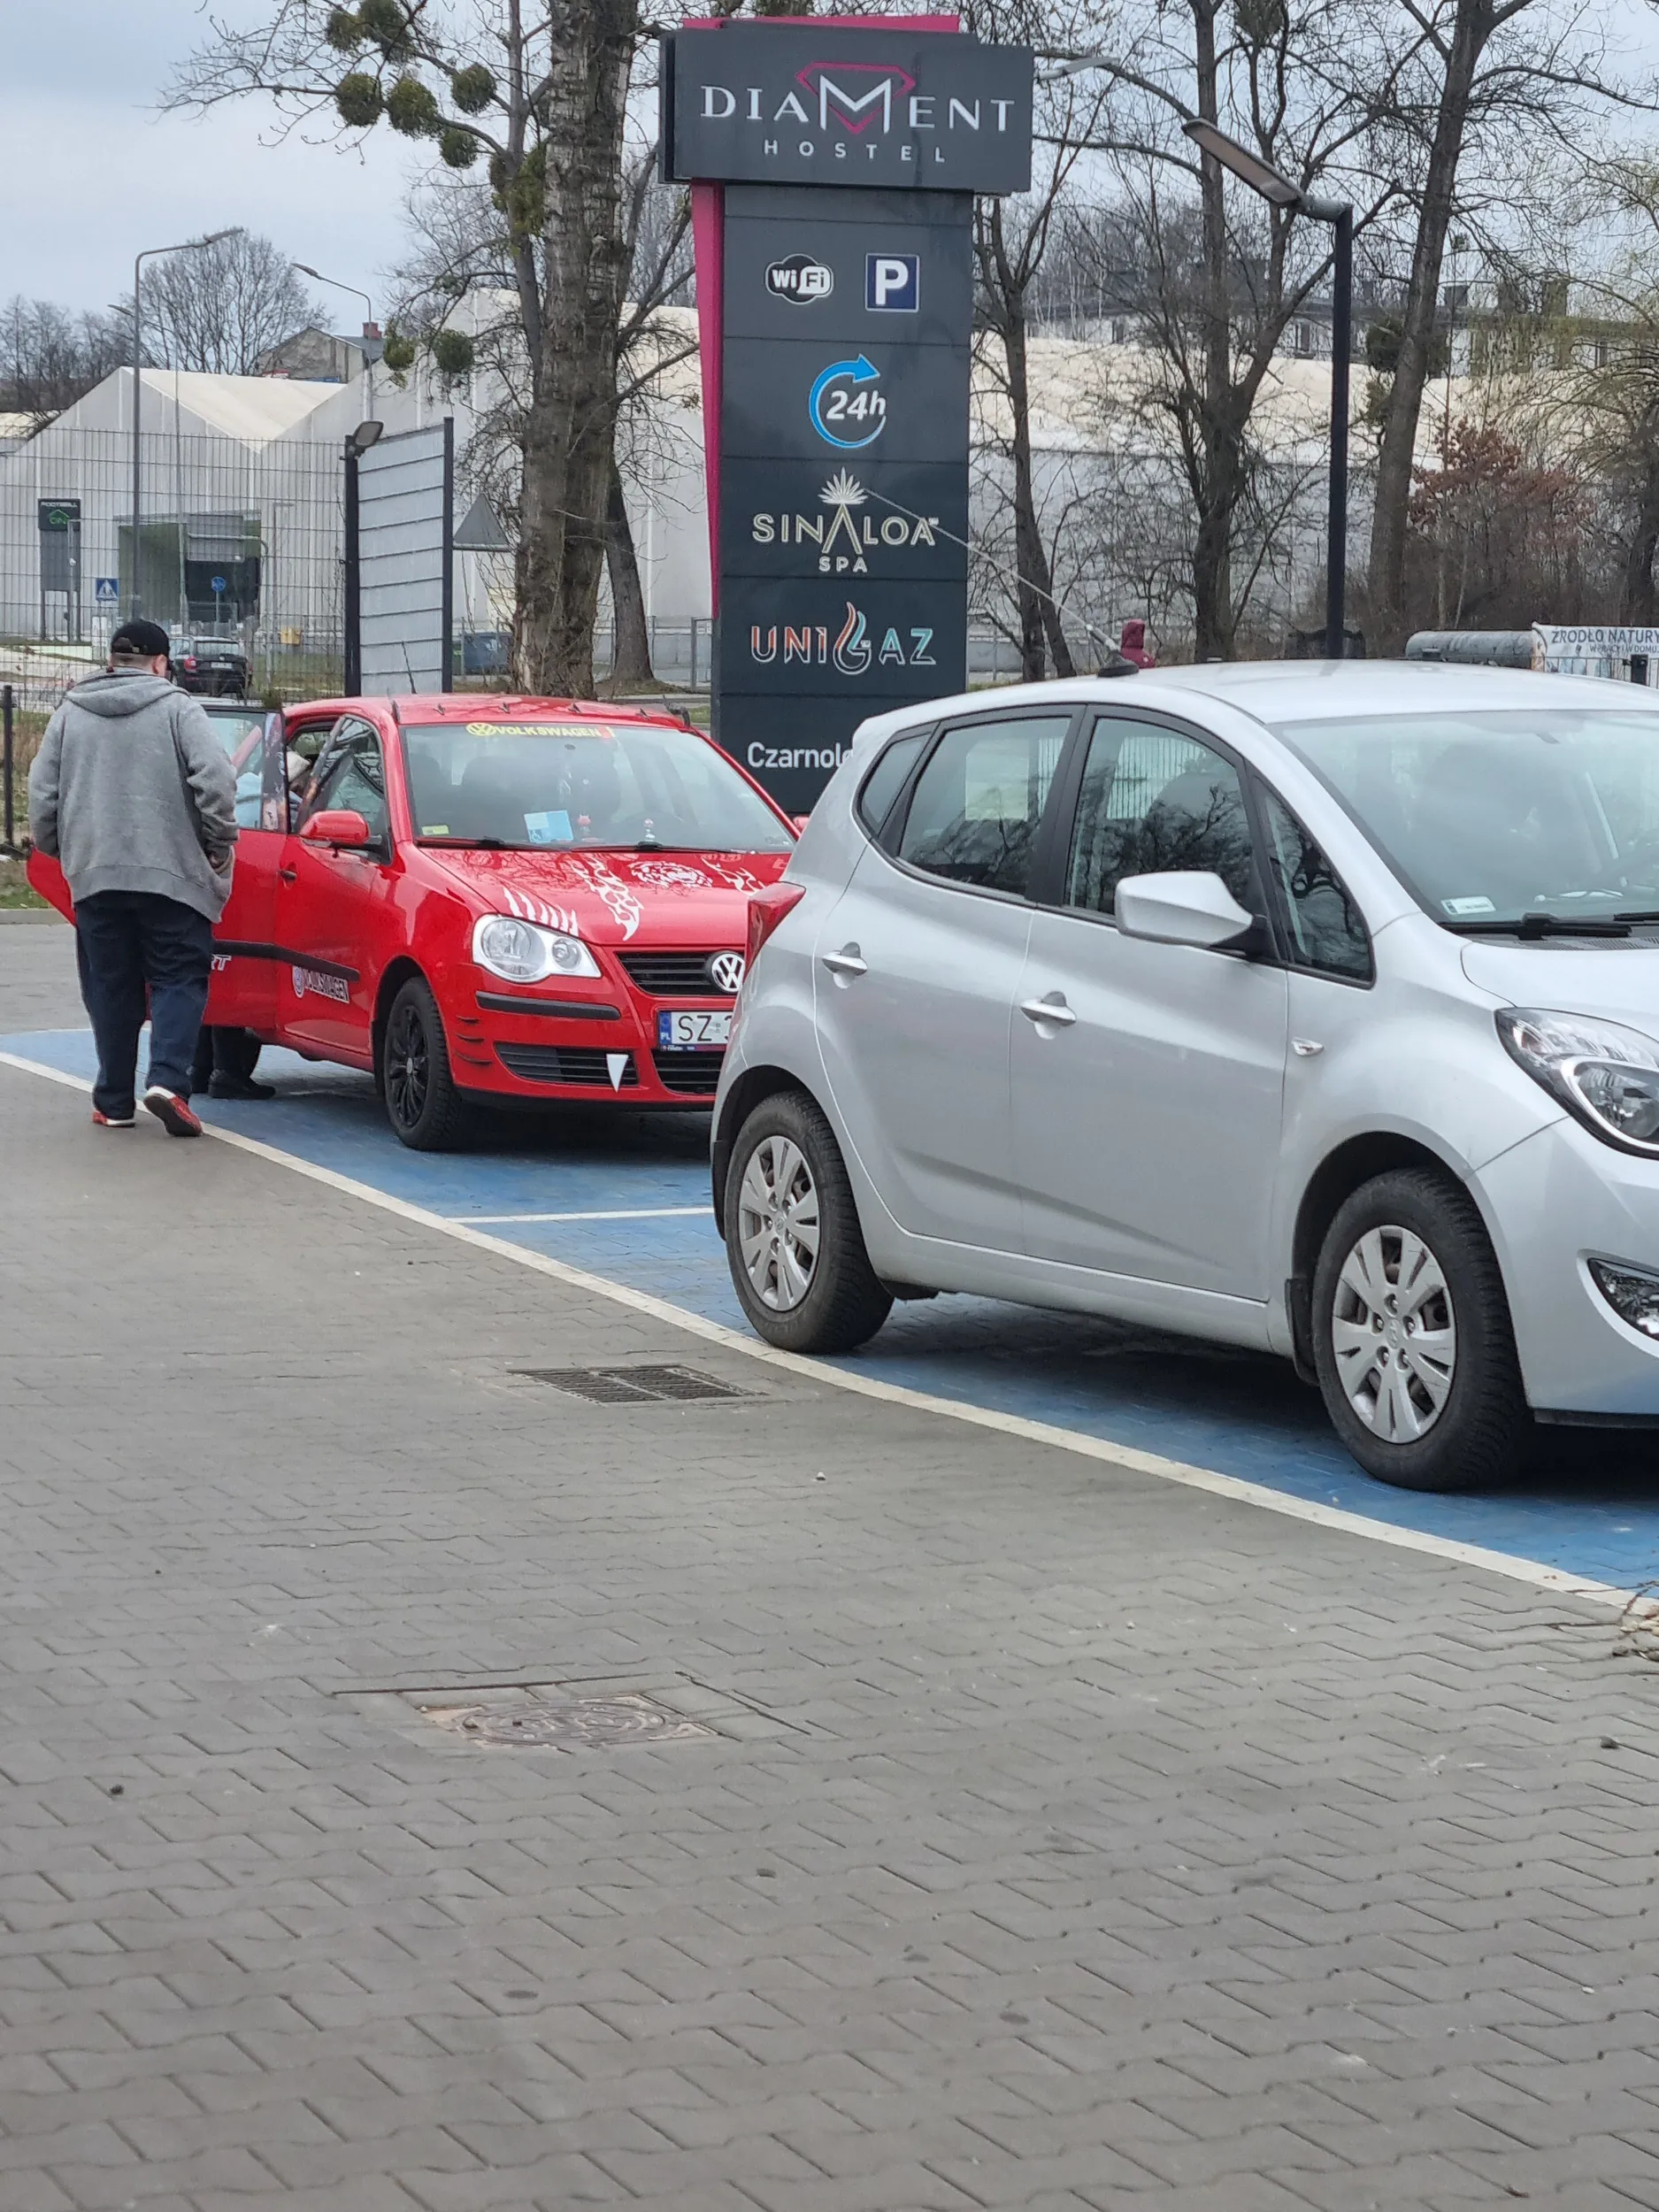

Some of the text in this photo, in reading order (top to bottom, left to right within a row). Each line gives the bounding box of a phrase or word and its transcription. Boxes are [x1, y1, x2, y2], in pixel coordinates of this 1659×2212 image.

[701, 74, 1016, 134] DIAMENT
[764, 139, 946, 164] HOSTEL
[875, 259, 909, 305] P
[826, 390, 886, 421] 24h
[751, 503, 936, 555] SINALOA
[818, 557, 868, 573] SPA
[751, 602, 937, 675] UNIGAZ
[494, 726, 603, 738] VOLKSWAGEN
[660, 1032, 671, 1041] PL
[678, 1015, 712, 1041] SZ
